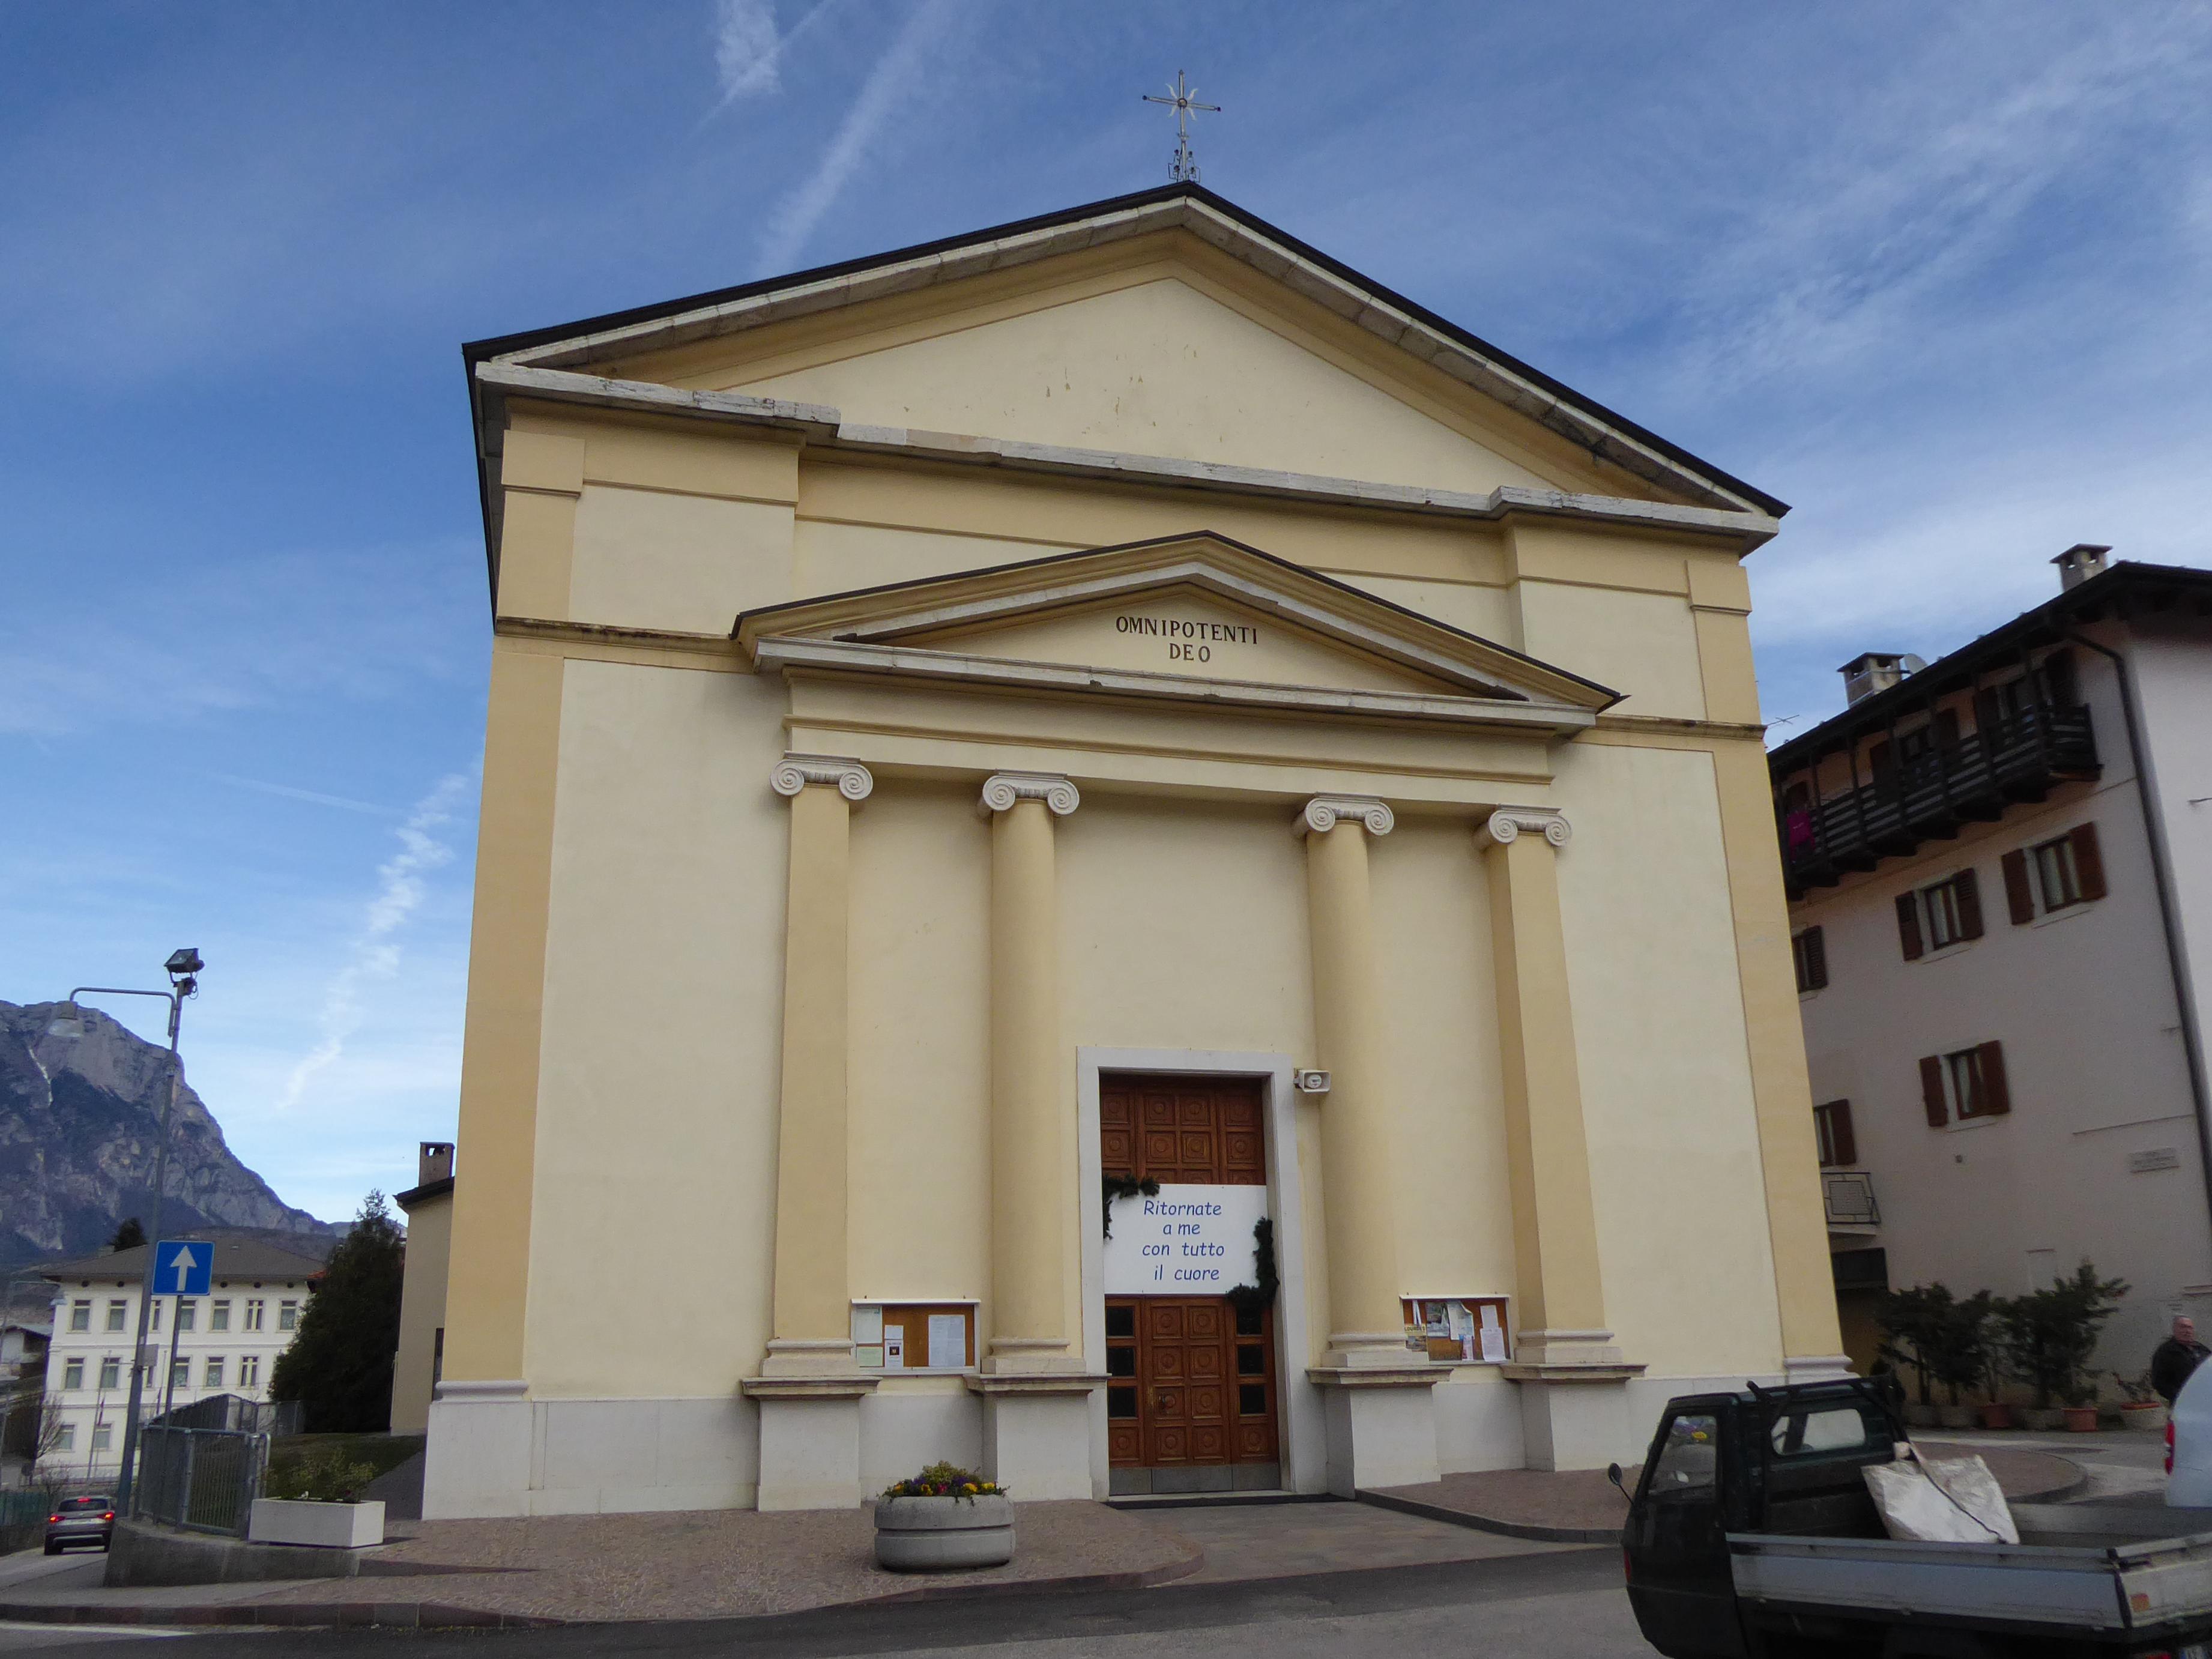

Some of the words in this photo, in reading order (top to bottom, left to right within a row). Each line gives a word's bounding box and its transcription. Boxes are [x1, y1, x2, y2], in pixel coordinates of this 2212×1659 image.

[1116, 616, 1257, 644] OMNIPOTENTI
[1169, 642, 1210, 663] DEO
[1143, 1200, 1222, 1215] Ritornate
[1162, 1224, 1171, 1234] a
[1177, 1223, 1200, 1235] me
[1142, 1244, 1170, 1256] con
[1182, 1242, 1224, 1256] tutto
[1155, 1265, 1163, 1280] il
[1174, 1269, 1219, 1280] cuore
